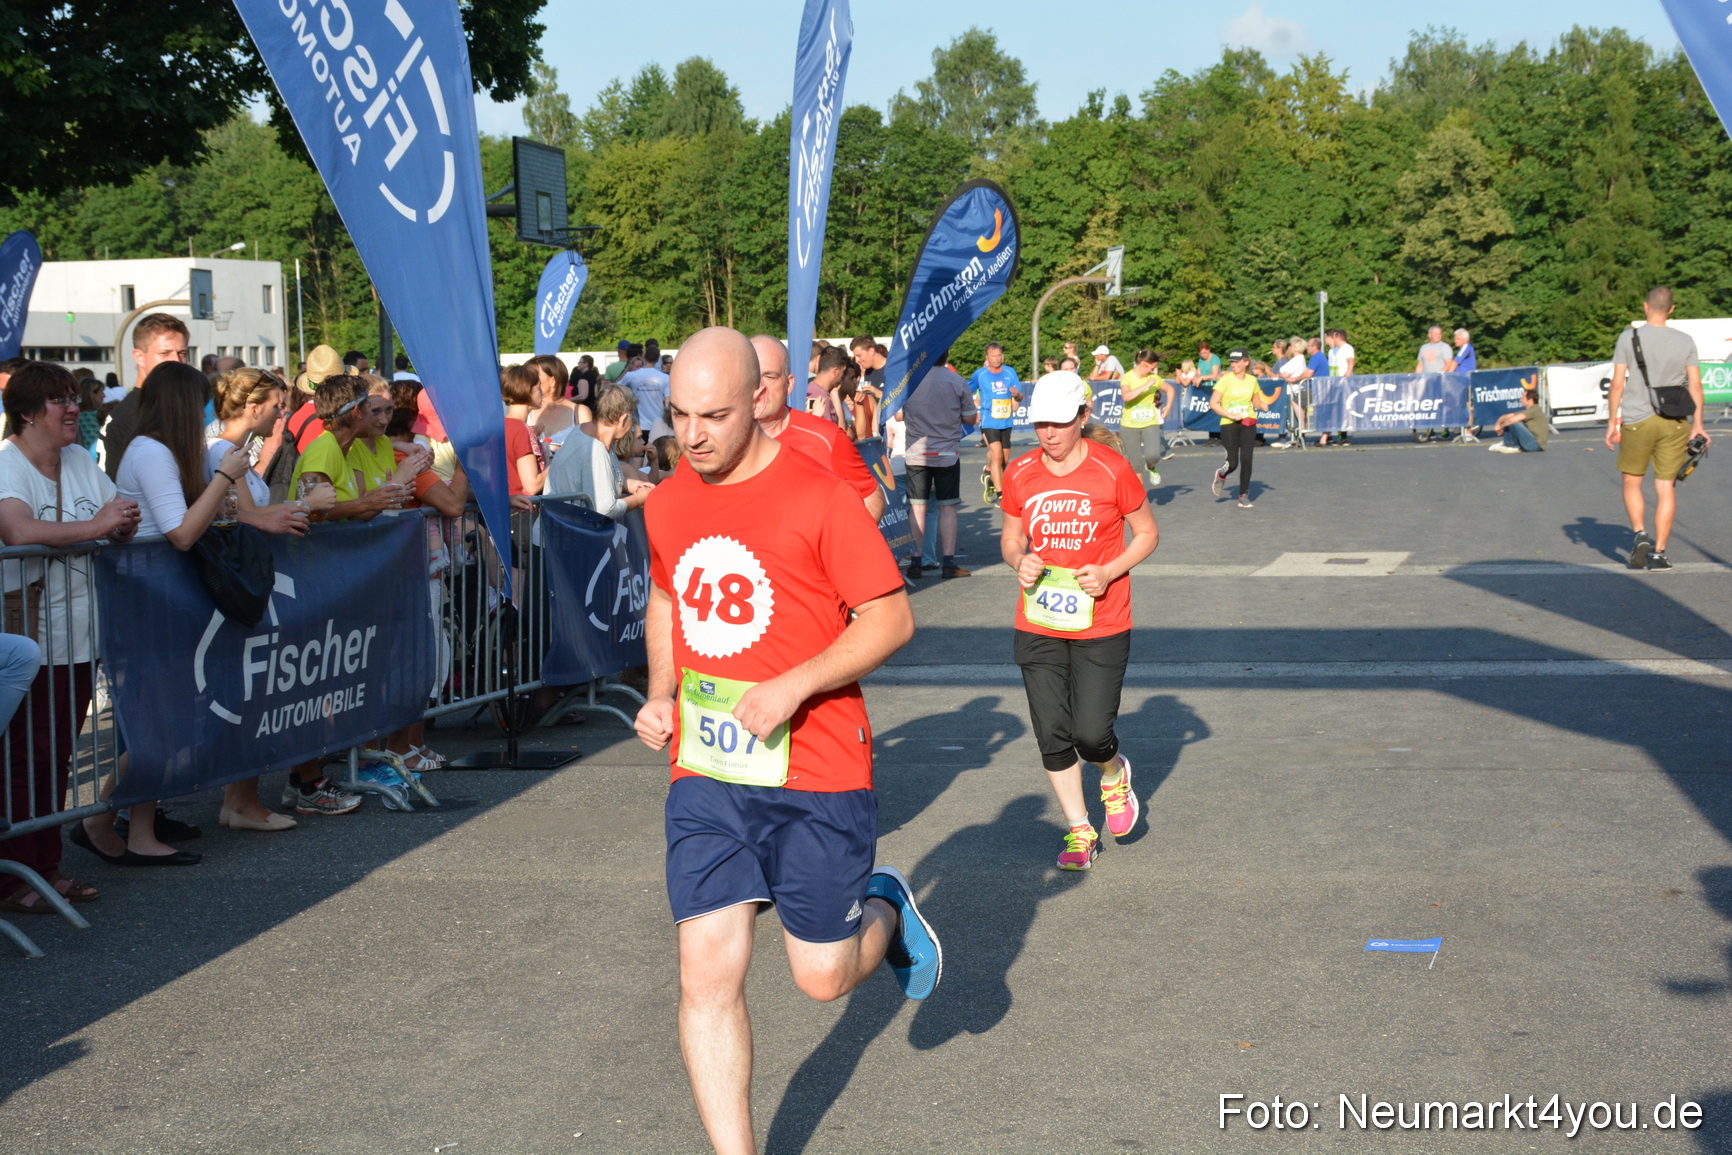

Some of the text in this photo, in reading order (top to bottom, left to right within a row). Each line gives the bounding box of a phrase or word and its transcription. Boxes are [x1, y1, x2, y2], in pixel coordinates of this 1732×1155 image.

[1, 248, 30, 329] Fischer
[952, 286, 974, 312] Druck
[987, 246, 1013, 279] Medien
[547, 264, 577, 327] Fischer
[557, 275, 580, 327] AUTOMOBILE
[900, 256, 984, 350] Frischmann
[1101, 402, 1122, 416] Fis
[1190, 396, 1210, 412] Fris
[1363, 397, 1443, 413] Fischer
[1475, 385, 1524, 403] Frischmann
[1135, 411, 1150, 419] 632
[1371, 412, 1437, 421] AUTOMOBILE
[1025, 490, 1092, 521] Town &
[1029, 514, 1099, 552] Country
[1051, 538, 1082, 551] HAUS
[1036, 590, 1078, 614] 428
[243, 618, 377, 702] Fischer
[255, 682, 366, 738] AUTOMOBILE
